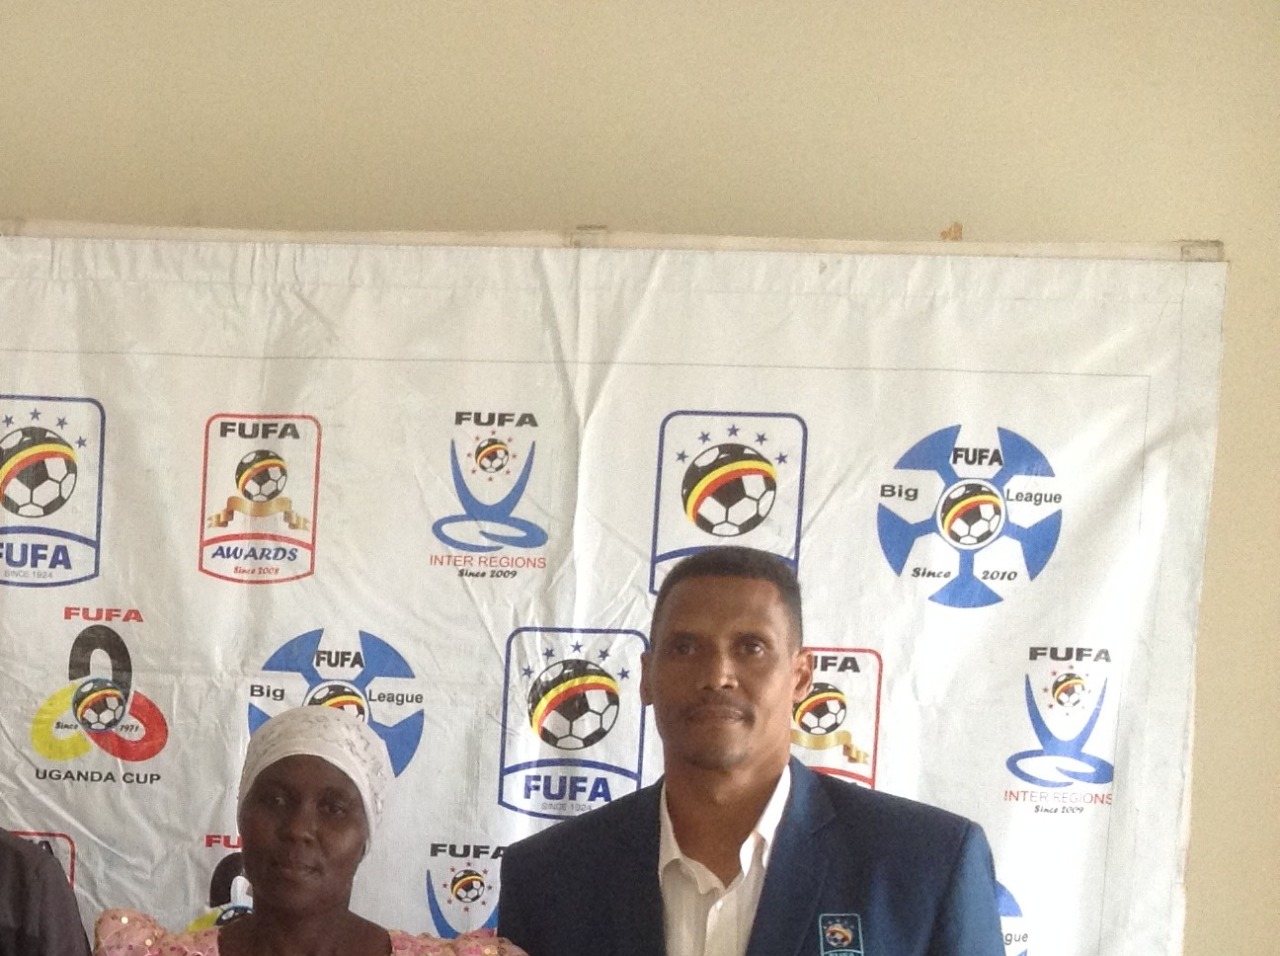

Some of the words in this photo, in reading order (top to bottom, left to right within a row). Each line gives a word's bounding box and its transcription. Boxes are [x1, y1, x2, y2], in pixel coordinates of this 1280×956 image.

[455, 411, 538, 427] FUFA
[219, 421, 300, 439] FUFA
[952, 447, 1003, 466] FUFA
[880, 484, 919, 501] Big
[1006, 489, 1062, 506] League
[211, 545, 298, 561] AWARDS
[233, 565, 256, 575] Since
[430, 555, 473, 567] INTER
[478, 556, 546, 569] REGIONS
[458, 568, 486, 578] Since
[489, 569, 517, 579] 2009
[911, 567, 951, 579] Since
[982, 569, 1018, 581] 2010
[64, 607, 144, 623] FUFA
[315, 650, 365, 668] FUFA
[1029, 647, 1111, 662] FUFA
[813, 656, 860, 673] FA
[250, 684, 285, 701] Big
[368, 689, 424, 705] League
[55, 721, 78, 731] Since
[35, 769, 116, 783] UGANDA
[122, 772, 161, 785] CUP
[523, 775, 612, 802] FUFA
[1004, 791, 1048, 803] INTER
[1055, 792, 1113, 805] REGIONS
[1034, 805, 1058, 814] Since
[205, 835, 242, 849] FU
[1003, 932, 1028, 946] gue
